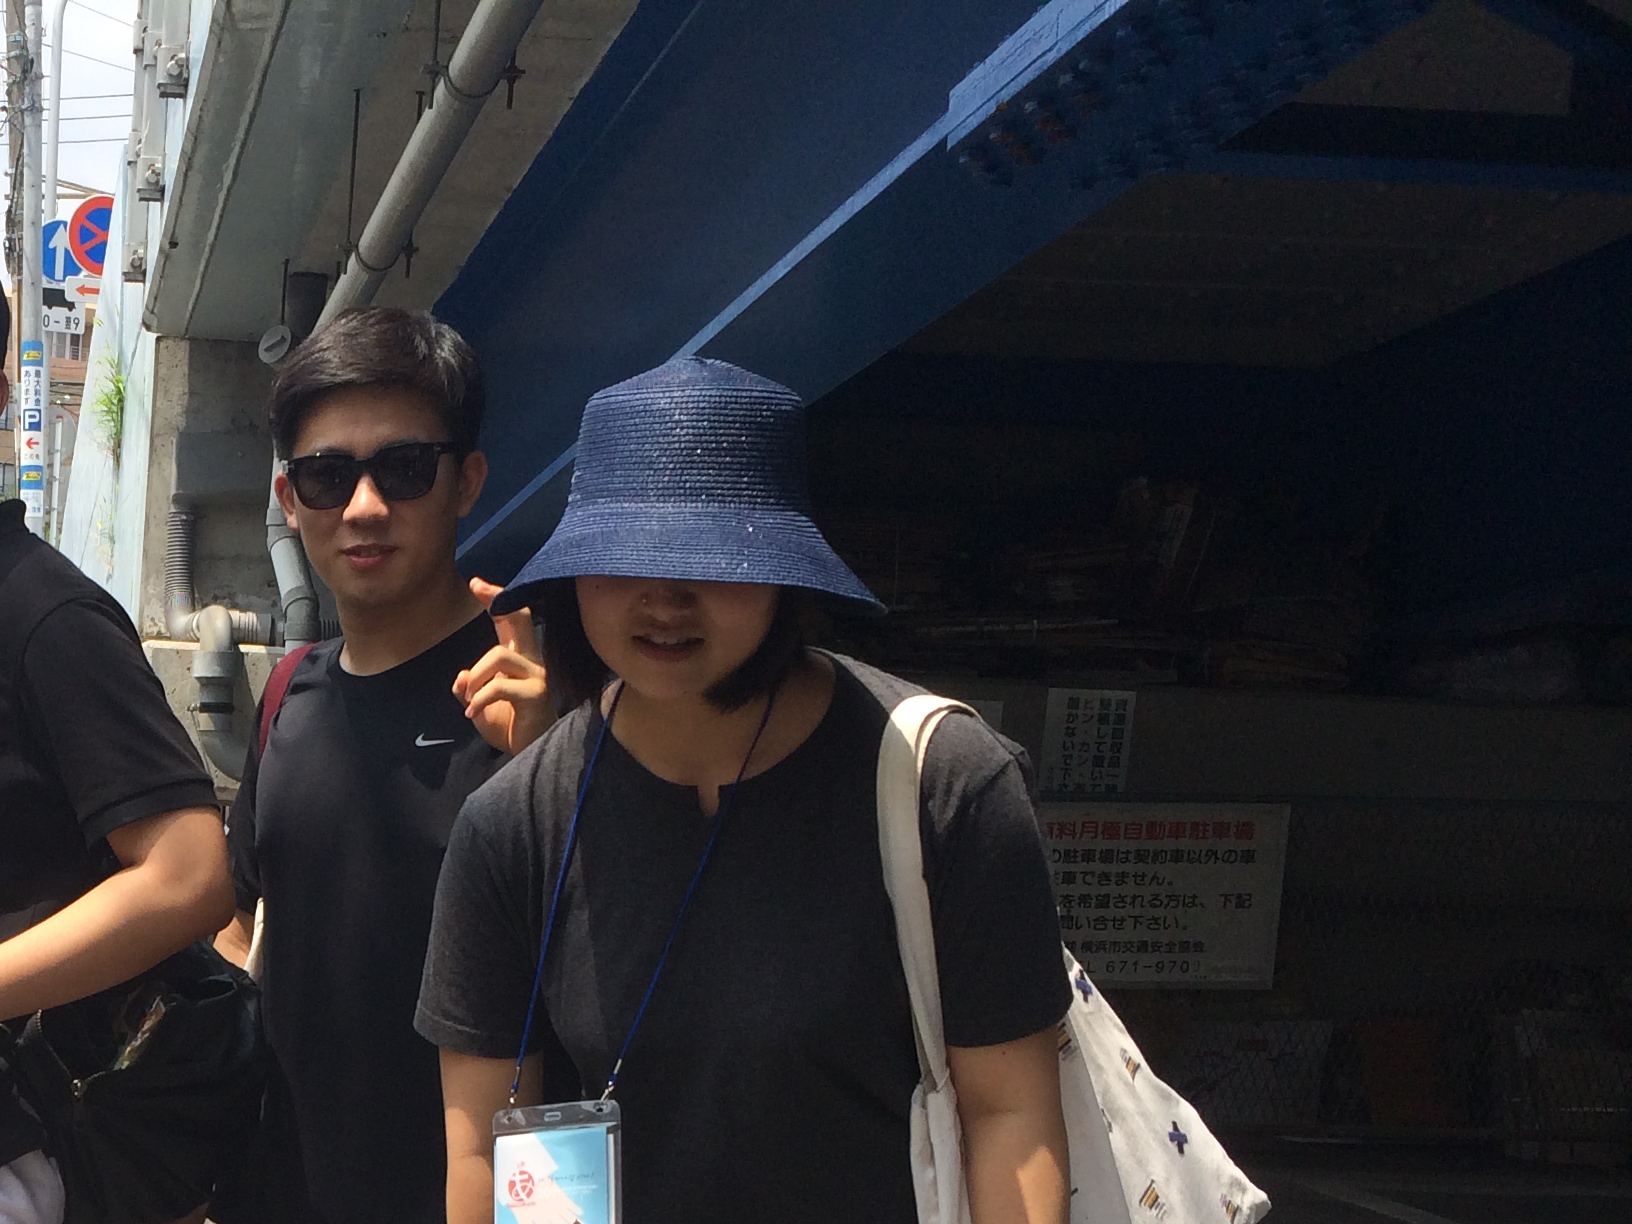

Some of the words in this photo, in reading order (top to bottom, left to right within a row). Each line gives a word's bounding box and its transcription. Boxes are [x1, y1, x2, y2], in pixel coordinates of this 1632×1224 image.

[1053, 870, 1176, 887] 車できません。
